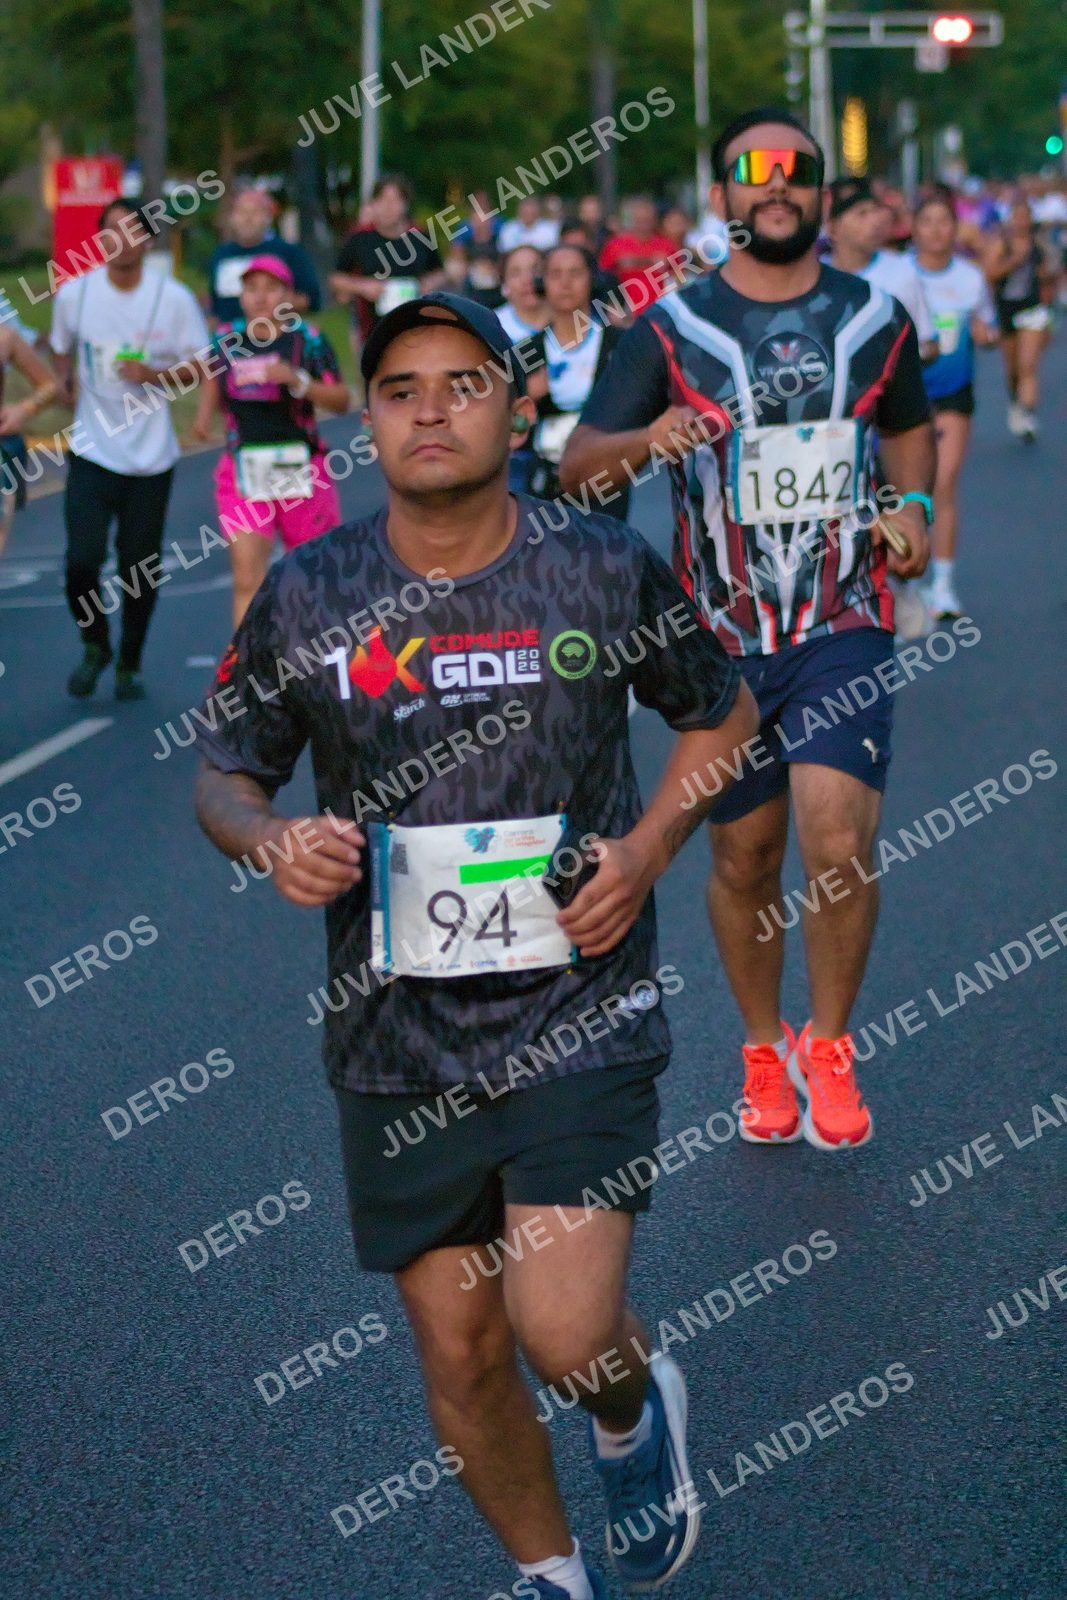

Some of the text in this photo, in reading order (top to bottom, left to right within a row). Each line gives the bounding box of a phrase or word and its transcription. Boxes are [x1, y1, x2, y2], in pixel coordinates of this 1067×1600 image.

[747, 461, 851, 511] 1842
[429, 629, 539, 652] COMUDE
[517, 650, 539, 660] 20
[432, 650, 541, 690] GDL
[517, 660, 540, 672] 26
[427, 886, 517, 953] 94
